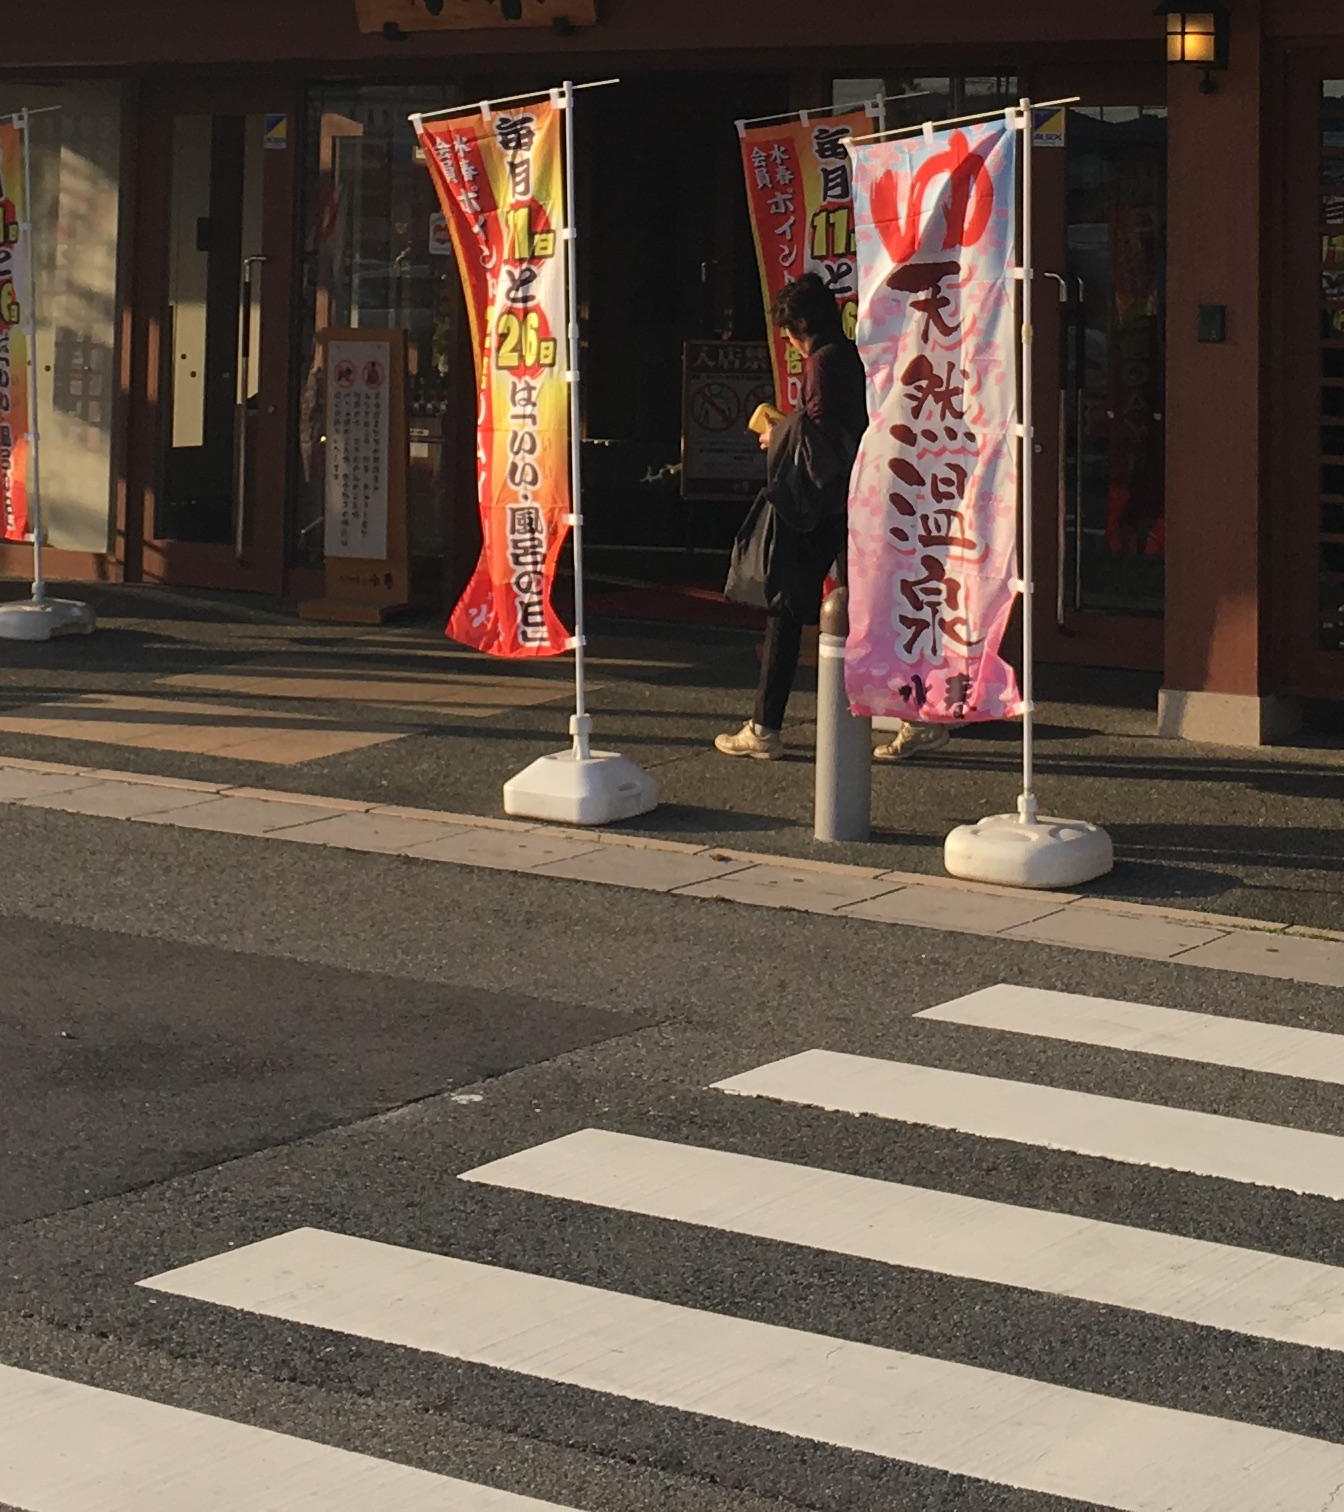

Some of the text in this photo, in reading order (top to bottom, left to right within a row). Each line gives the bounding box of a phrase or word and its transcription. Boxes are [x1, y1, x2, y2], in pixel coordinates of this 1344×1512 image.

[751, 146, 773, 188] 会員
[770, 144, 794, 185] 水春
[869, 128, 994, 264] ゆ
[886, 261, 984, 658] 天然温泉
